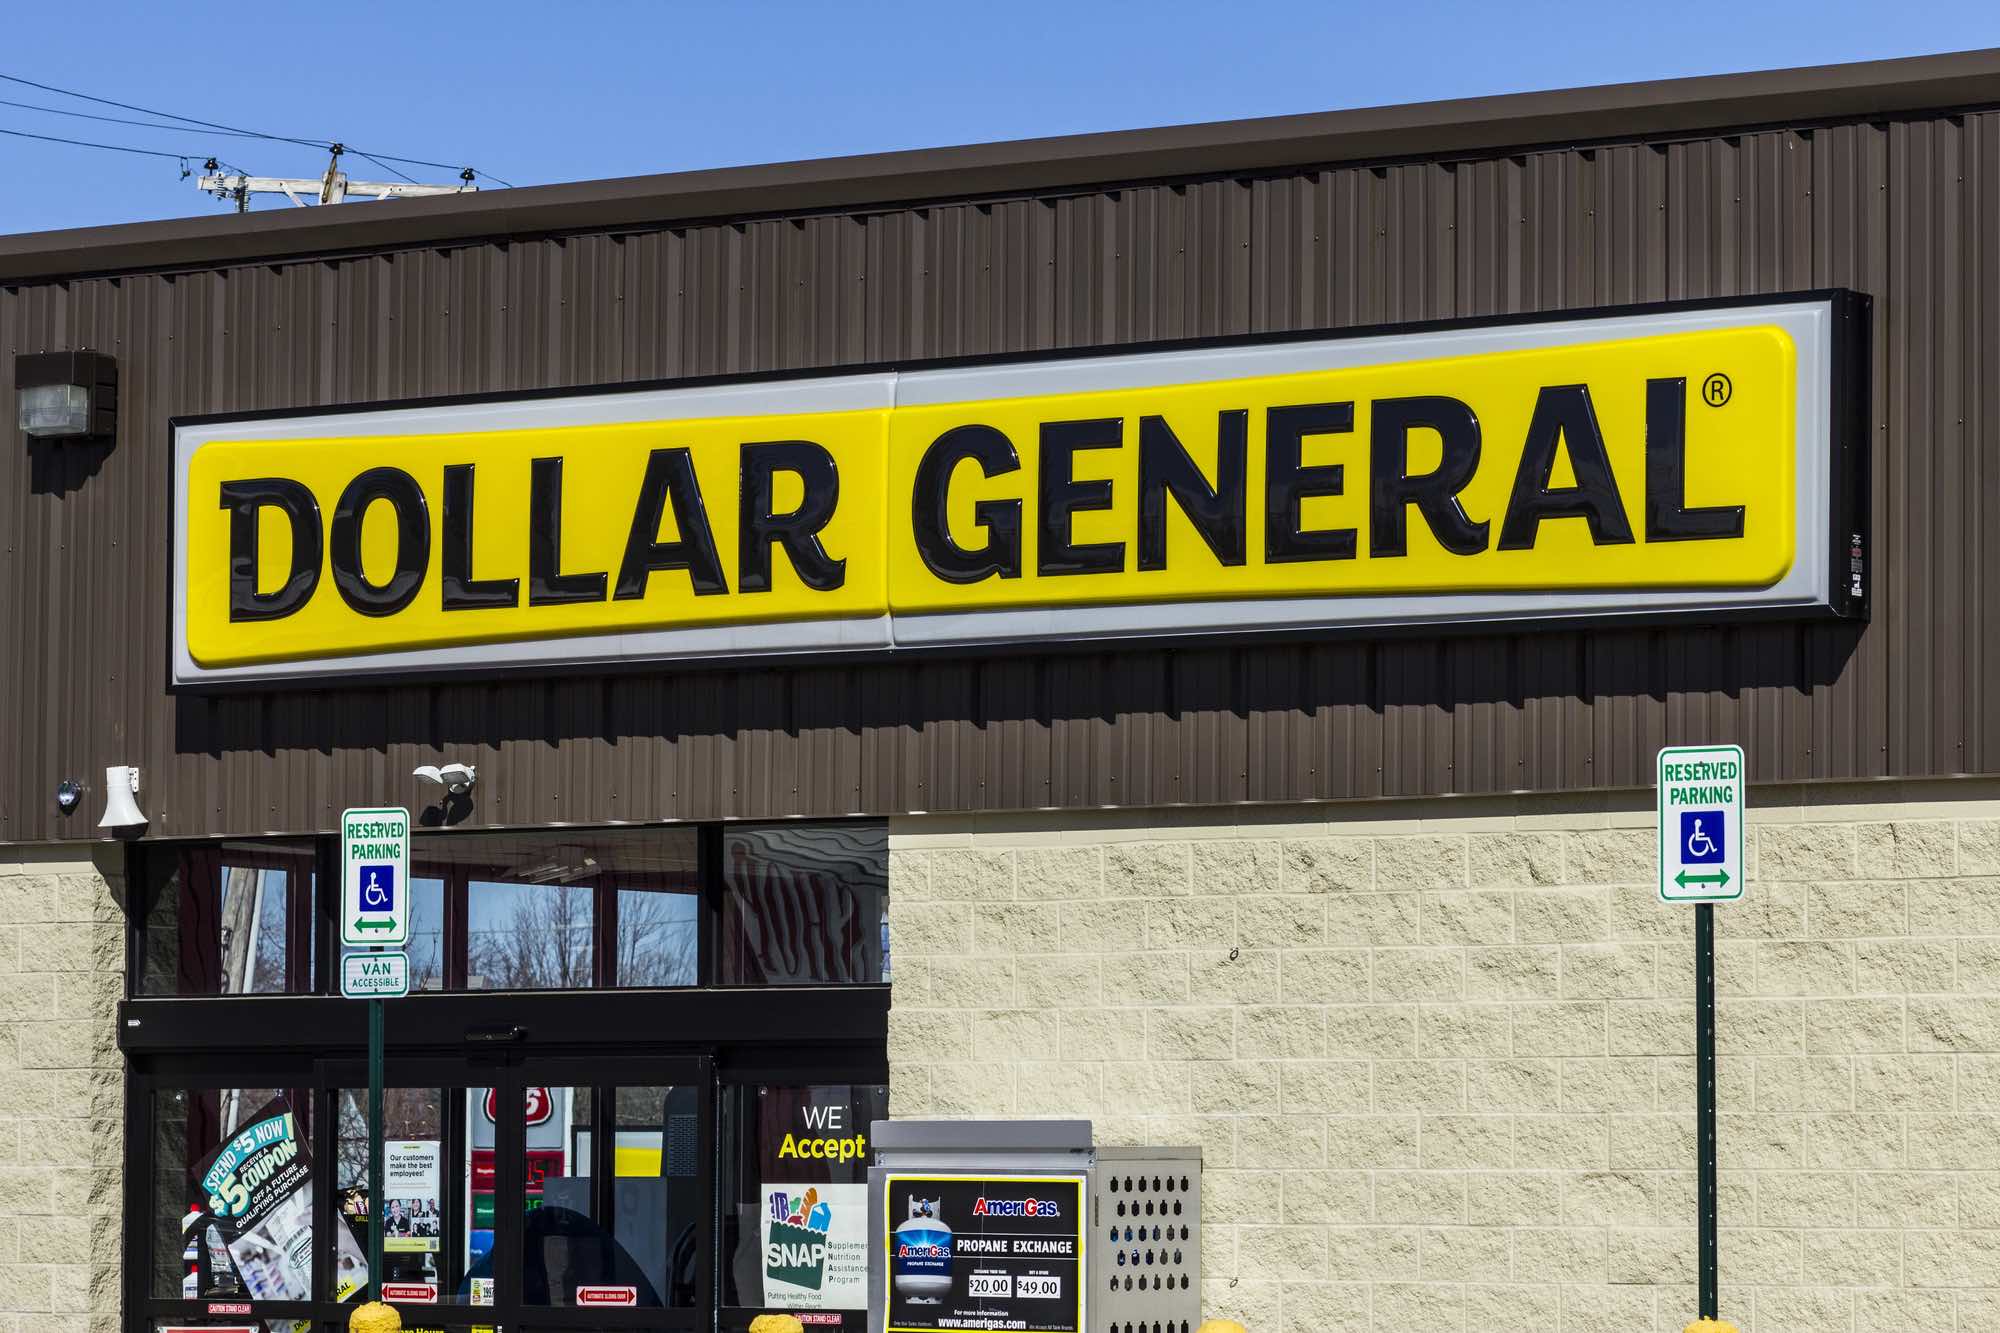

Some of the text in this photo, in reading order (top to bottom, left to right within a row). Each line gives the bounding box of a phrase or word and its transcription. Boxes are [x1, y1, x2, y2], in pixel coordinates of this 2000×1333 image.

[219, 440, 847, 624] DOLLAR
[912, 375, 1745, 586] GENERAL
[1665, 761, 1737, 782] RESERVED
[1670, 785, 1733, 805] PARKING
[347, 822, 404, 839] RESERVED
[351, 843, 401, 860] PARKING
[362, 962, 391, 976] VAN
[352, 977, 400, 988] ACCESSIBLE
[802, 1106, 843, 1129] WE
[778, 1134, 866, 1164] Accept
[206, 1150, 237, 1191] SPEND
[233, 1131, 256, 1153] $5
[239, 1147, 269, 1174] RECEIVE A
[390, 1170, 425, 1178] employees!
[252, 1189, 265, 1204] OFF
[265, 1185, 272, 1194] A
[271, 1163, 298, 1187] FUTURE
[209, 1171, 251, 1217] $5
[236, 1193, 274, 1229] QUALIFYING
[274, 1165, 309, 1197] PURCHASE
[973, 1197, 1058, 1217] AmeriGas
[767, 1242, 825, 1268] SNAP
[957, 1239, 1073, 1254] PROPANE EXCHANGE
[828, 1253, 861, 1261] Nutrition
[828, 1276, 860, 1285] Program
[969, 1279, 1009, 1294] $20.00
[1017, 1281, 1058, 1295] $49.00
[768, 1292, 787, 1300] Putting
[808, 1292, 822, 1300] Food
[938, 1317, 1027, 1330] www.amerigas.com
